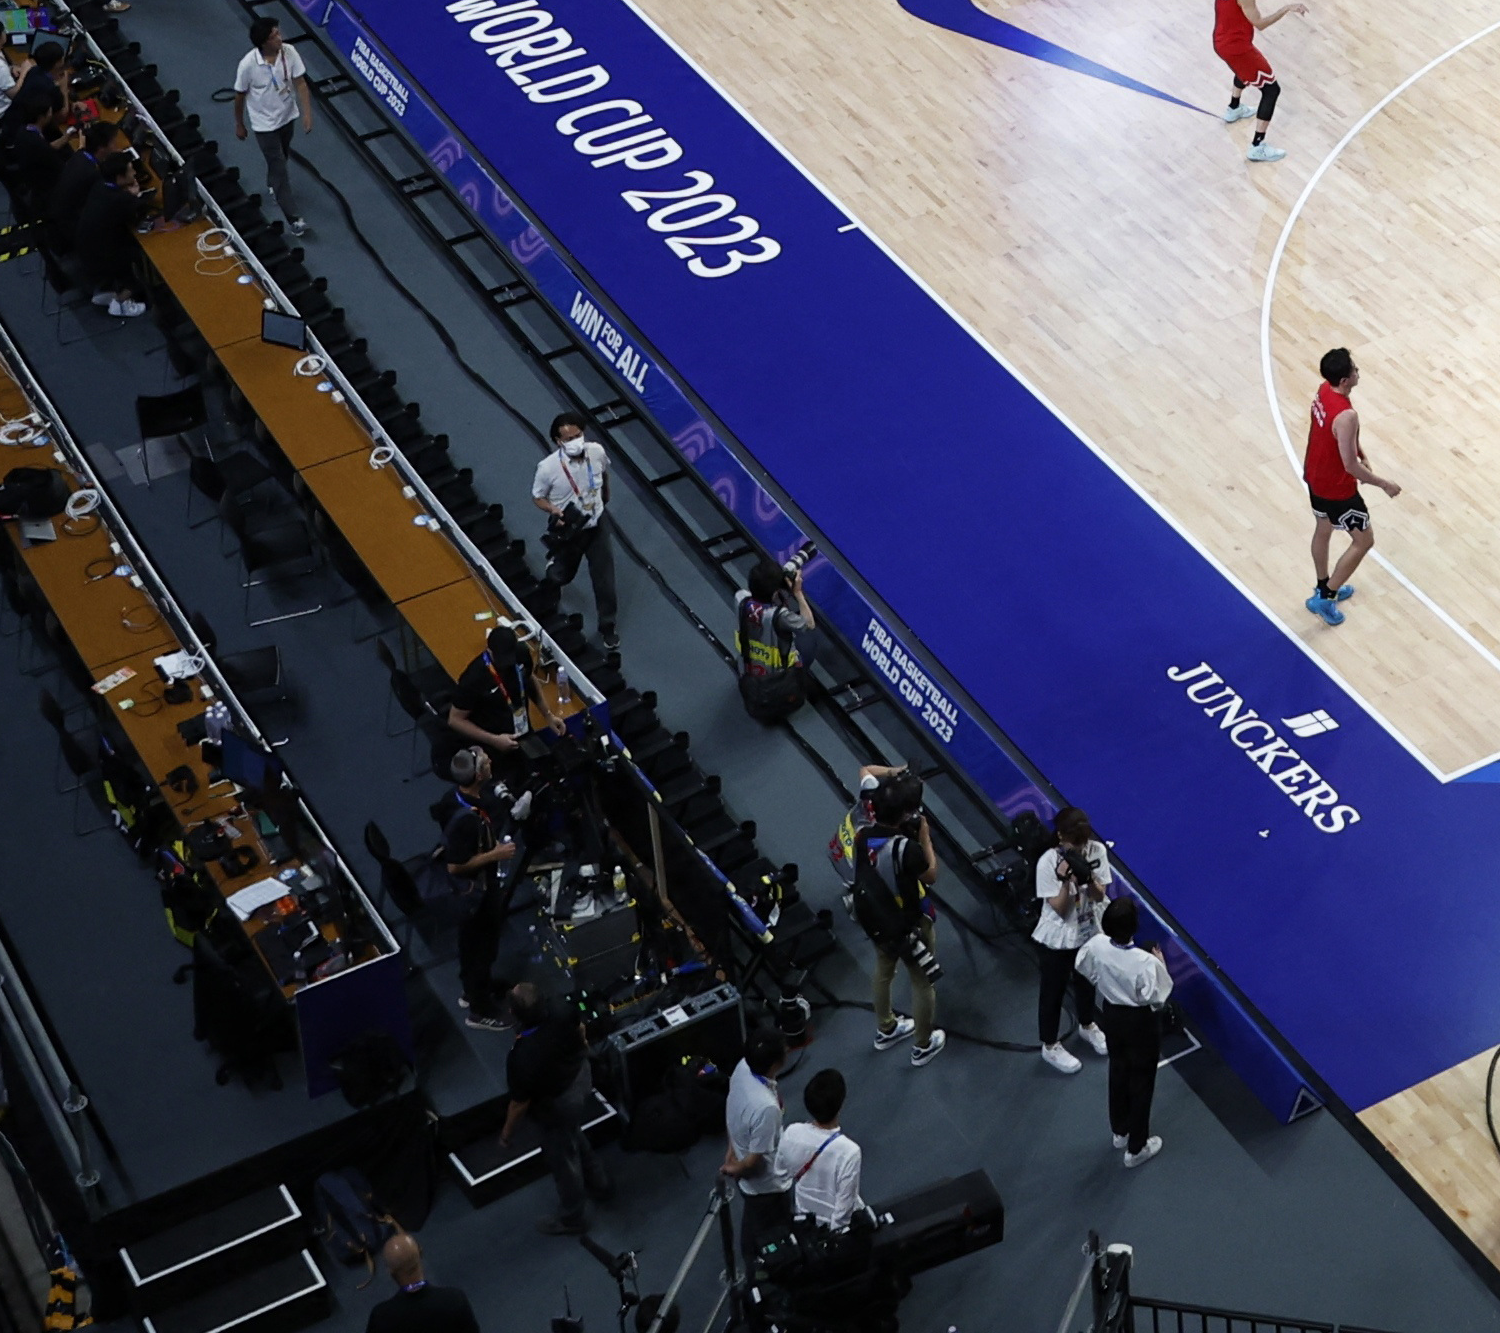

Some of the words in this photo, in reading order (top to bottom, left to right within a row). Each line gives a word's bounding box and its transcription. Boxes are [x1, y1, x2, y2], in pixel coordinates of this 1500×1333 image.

[552, 95, 685, 173] CUP
[618, 165, 785, 283] 2023
[570, 290, 605, 342] WIN
[600, 321, 623, 353] FOR
[615, 345, 649, 394] ALL
[861, 632, 900, 684] WORLD
[898, 677, 924, 708] CUP
[920, 702, 954, 744] 2023
[868, 617, 893, 653] FIBA
[891, 644, 959, 726] BASKETBALL
[1168, 657, 1363, 837] JUNCKERS
